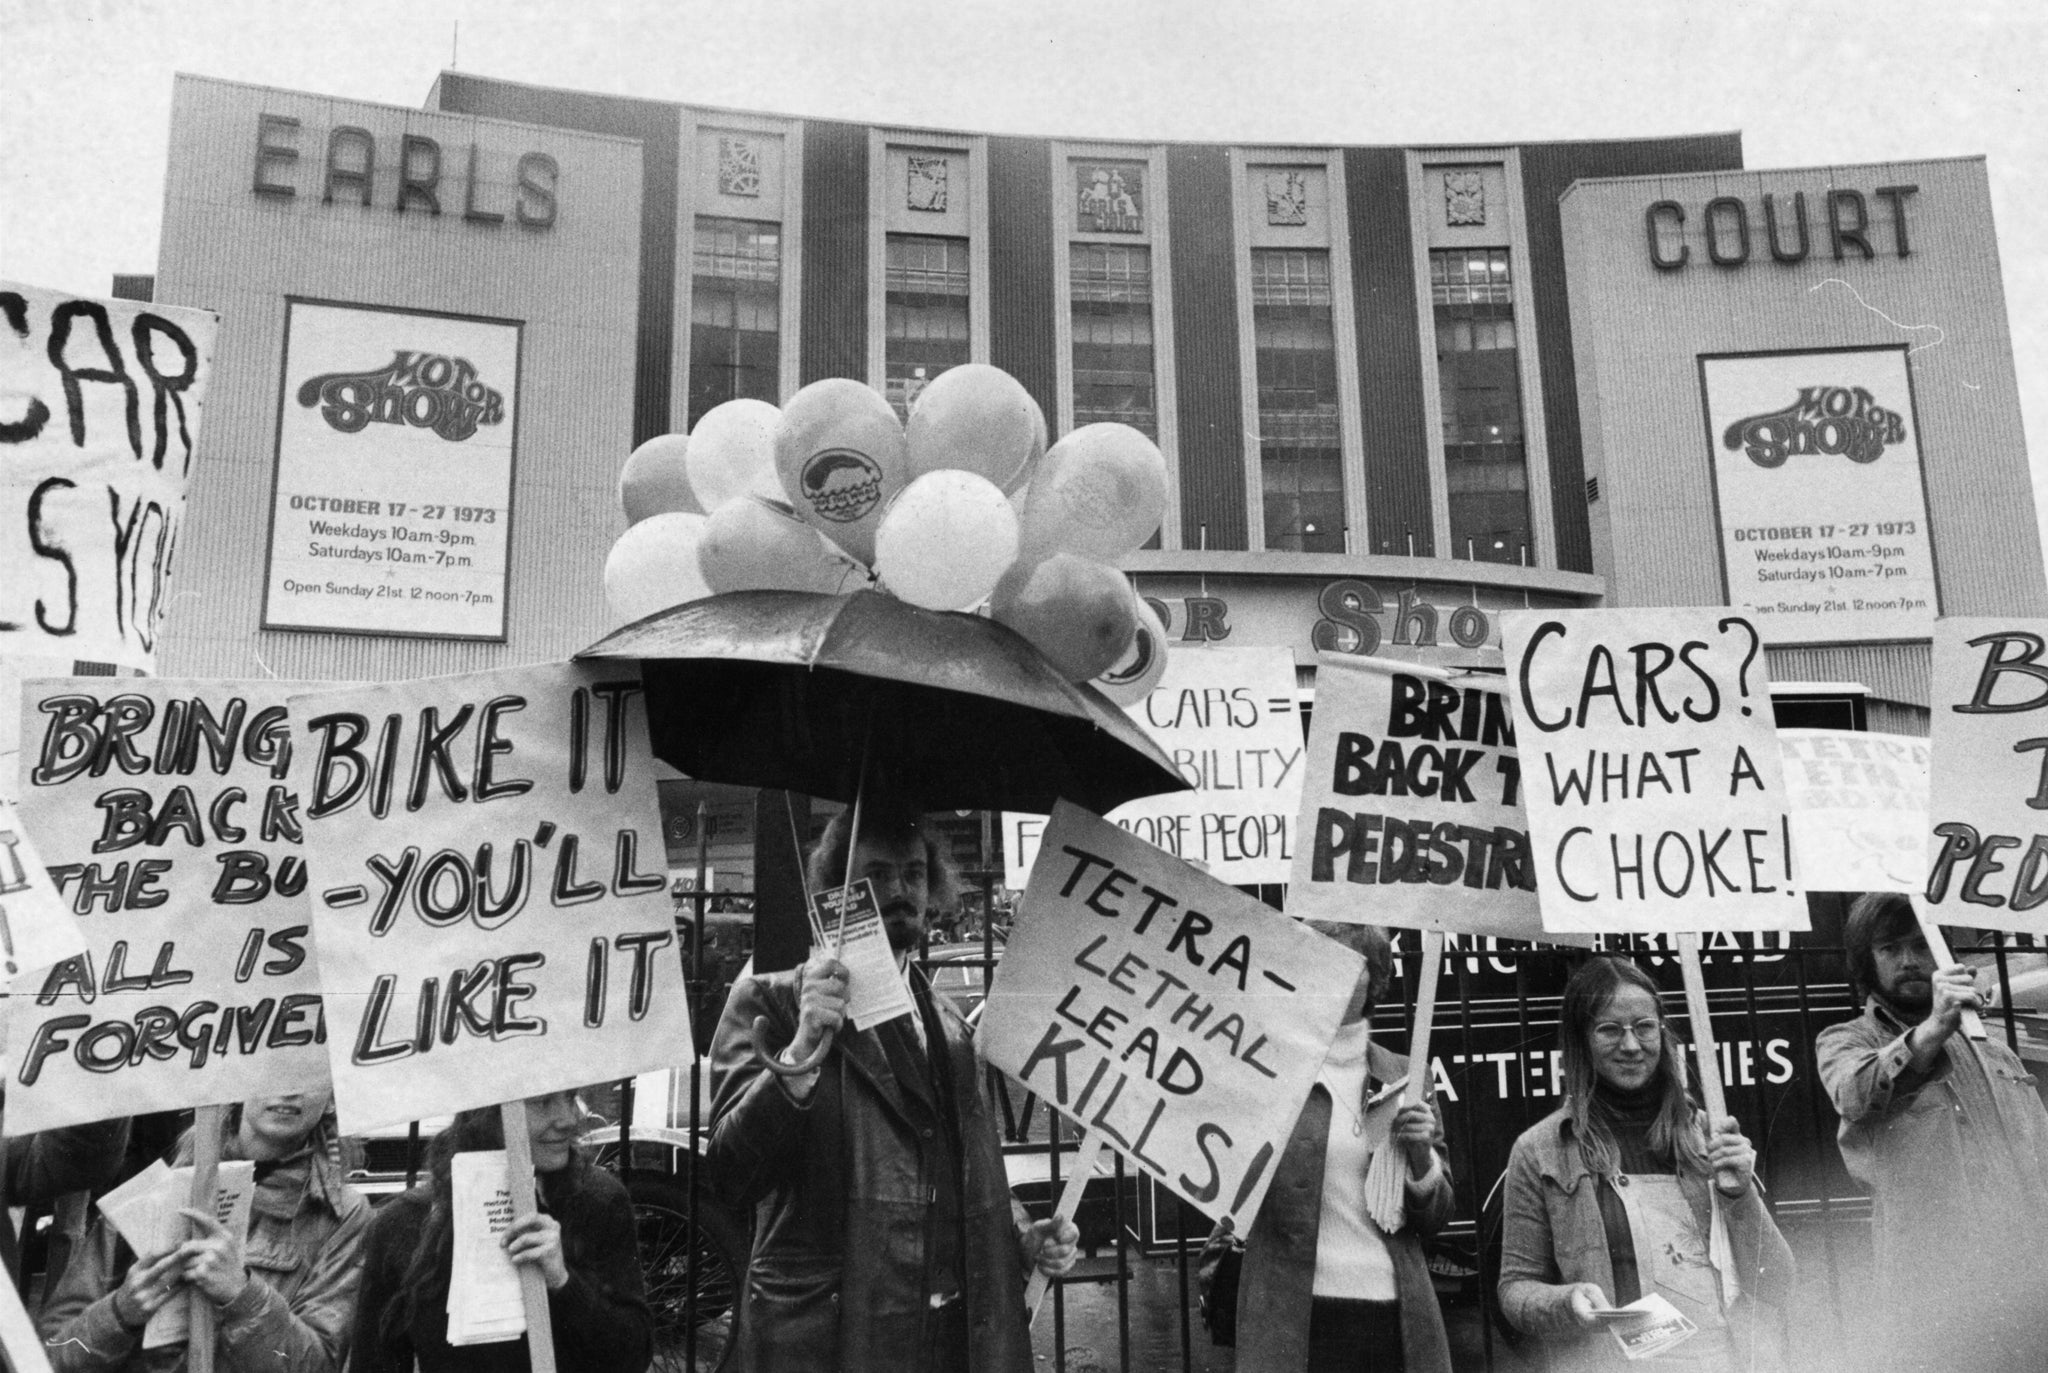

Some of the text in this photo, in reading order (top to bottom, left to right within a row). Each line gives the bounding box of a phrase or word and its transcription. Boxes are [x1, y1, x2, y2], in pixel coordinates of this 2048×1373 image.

[253, 112, 560, 231] EARLS
[1645, 184, 1919, 271] COURT
[289, 494, 381, 516] OCTOBER
[452, 505, 497, 525] 1973
[308, 519, 388, 544] Weekdays
[1734, 525, 1813, 542] OCTOBER
[1876, 520, 1917, 536] 1973
[308, 541, 383, 564] Saturdays
[1754, 546, 1826, 564] Weekdays
[1757, 567, 1827, 583] Saturdays
[283, 578, 322, 597] Open
[325, 580, 375, 600] Sunday
[1311, 579, 1490, 655] Sho
[1776, 600, 1822, 616] Sunday
[1146, 687, 1259, 729] CARS
[1519, 616, 1760, 733] CARS?
[31, 693, 293, 786] BRING
[1387, 673, 1518, 748] BRIN
[307, 680, 643, 820] BIKE IT
[1173, 747, 1302, 790] BILITY
[1332, 731, 1487, 803] BACK
[1545, 745, 1765, 806] WHAT A
[91, 785, 304, 854] BACK
[1201, 813, 1293, 862] PEOPL
[1311, 806, 1538, 893] PEDESTRI
[45, 859, 173, 916] THE
[211, 850, 308, 904] BU
[1555, 813, 1795, 903] CHOKE!
[821, 890, 867, 911] YOUSELF
[36, 925, 309, 1007] ALL IS
[350, 930, 672, 1066] LIKE IT
[18, 994, 327, 1087] FORGIVE
[1055, 985, 1204, 1096] LEAD
[1074, 934, 1278, 1080] LETHAL
